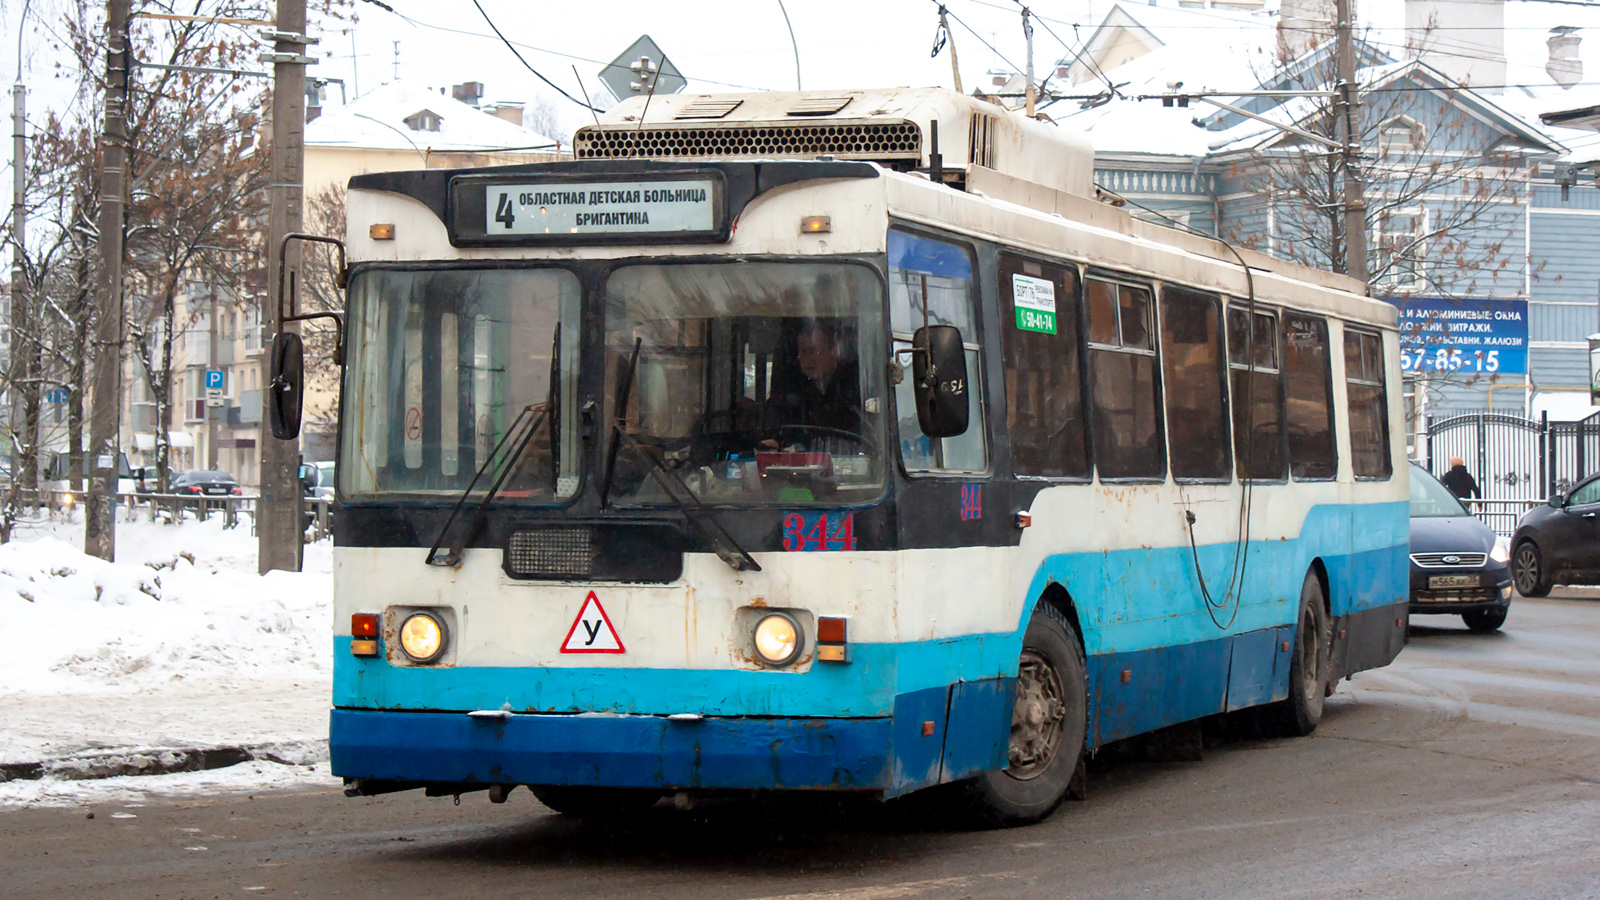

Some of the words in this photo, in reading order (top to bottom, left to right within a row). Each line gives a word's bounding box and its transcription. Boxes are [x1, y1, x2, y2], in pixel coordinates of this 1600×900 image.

[519, 191, 586, 206] ОБЛАСТНАЯ
[589, 190, 641, 206] ДЕТСКАЯ
[644, 188, 706, 204] БОЛЬНИЦА
[495, 192, 515, 229] 4
[575, 211, 649, 226] БРИГАНТИНА
[1026, 311, 1053, 331] 50-41-74
[1406, 309, 1413, 318] И
[1494, 311, 1522, 321] ОКНА
[1484, 336, 1522, 346] ЖАЛЮЗИ
[210, 372, 221, 387] P
[960, 484, 983, 521] 344
[783, 513, 857, 552] 344
